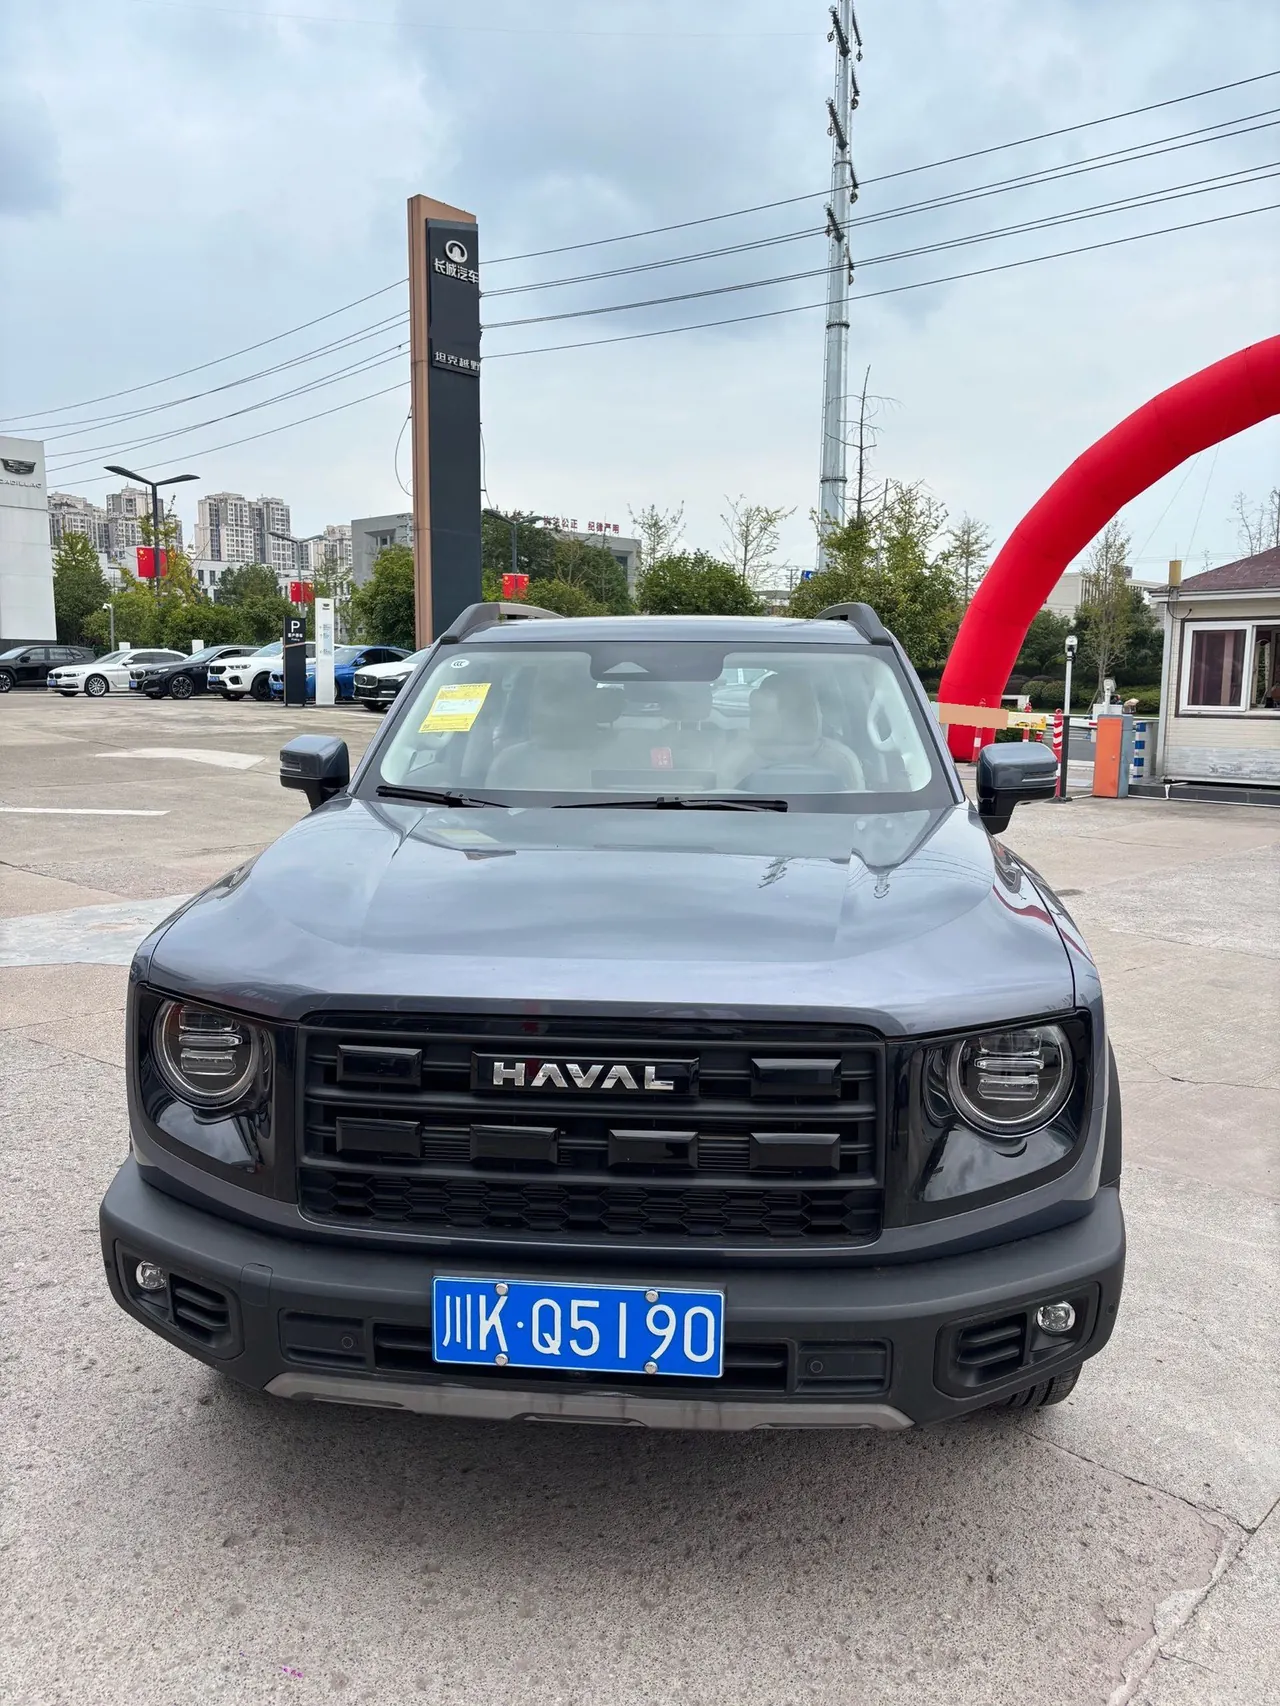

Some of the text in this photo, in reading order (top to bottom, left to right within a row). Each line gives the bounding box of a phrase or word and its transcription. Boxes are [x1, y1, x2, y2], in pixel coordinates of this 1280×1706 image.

[434, 258, 479, 283] 长城汽车
[434, 351, 480, 371] 坦克越野
[587, 521, 620, 534] 纪律严明
[291, 620, 300, 633] P
[493, 1062, 674, 1090] HAVAL
[442, 1293, 716, 1363] 川K·Q5190
